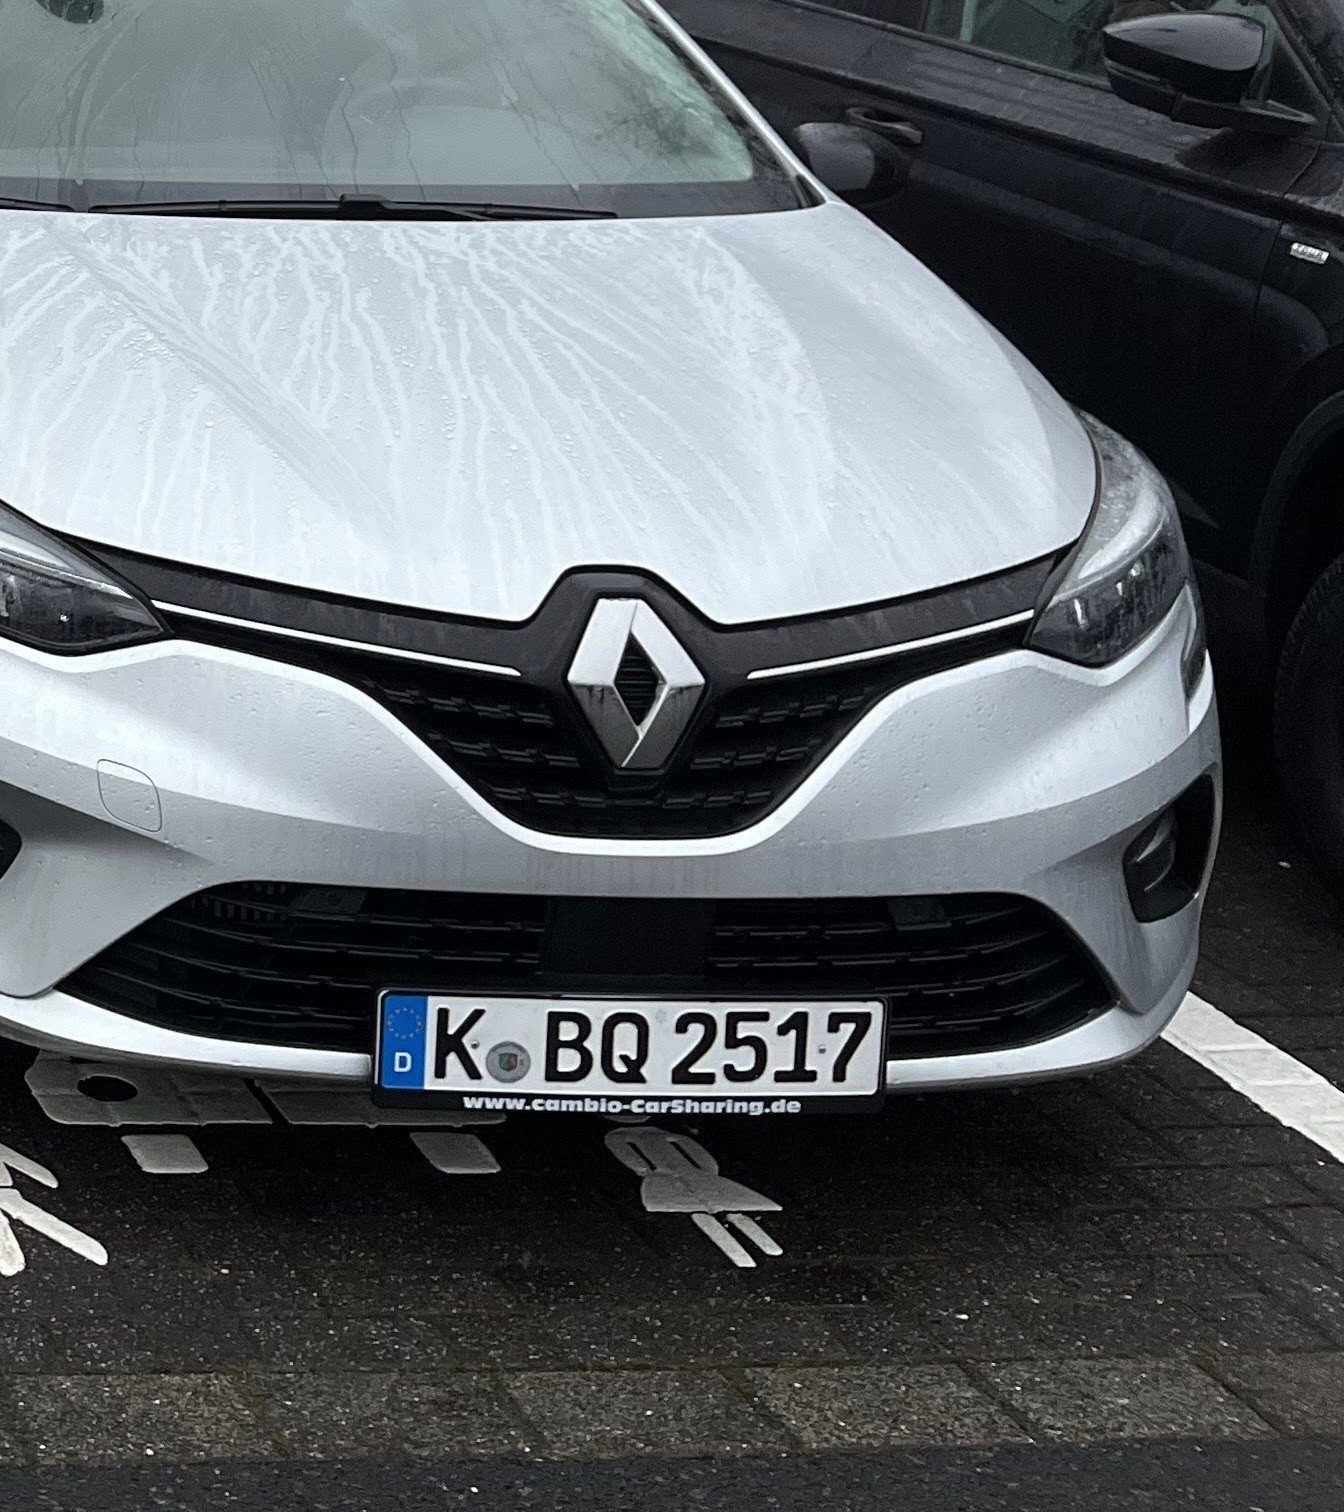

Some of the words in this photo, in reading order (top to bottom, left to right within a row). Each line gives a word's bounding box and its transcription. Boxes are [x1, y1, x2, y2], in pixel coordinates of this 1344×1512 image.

[432, 1006, 487, 1081] K
[543, 1009, 651, 1086] BQ
[670, 1010, 873, 1086] 2517
[394, 1052, 412, 1073] D
[462, 1094, 802, 1117] www.cambio-CarSharing.de
